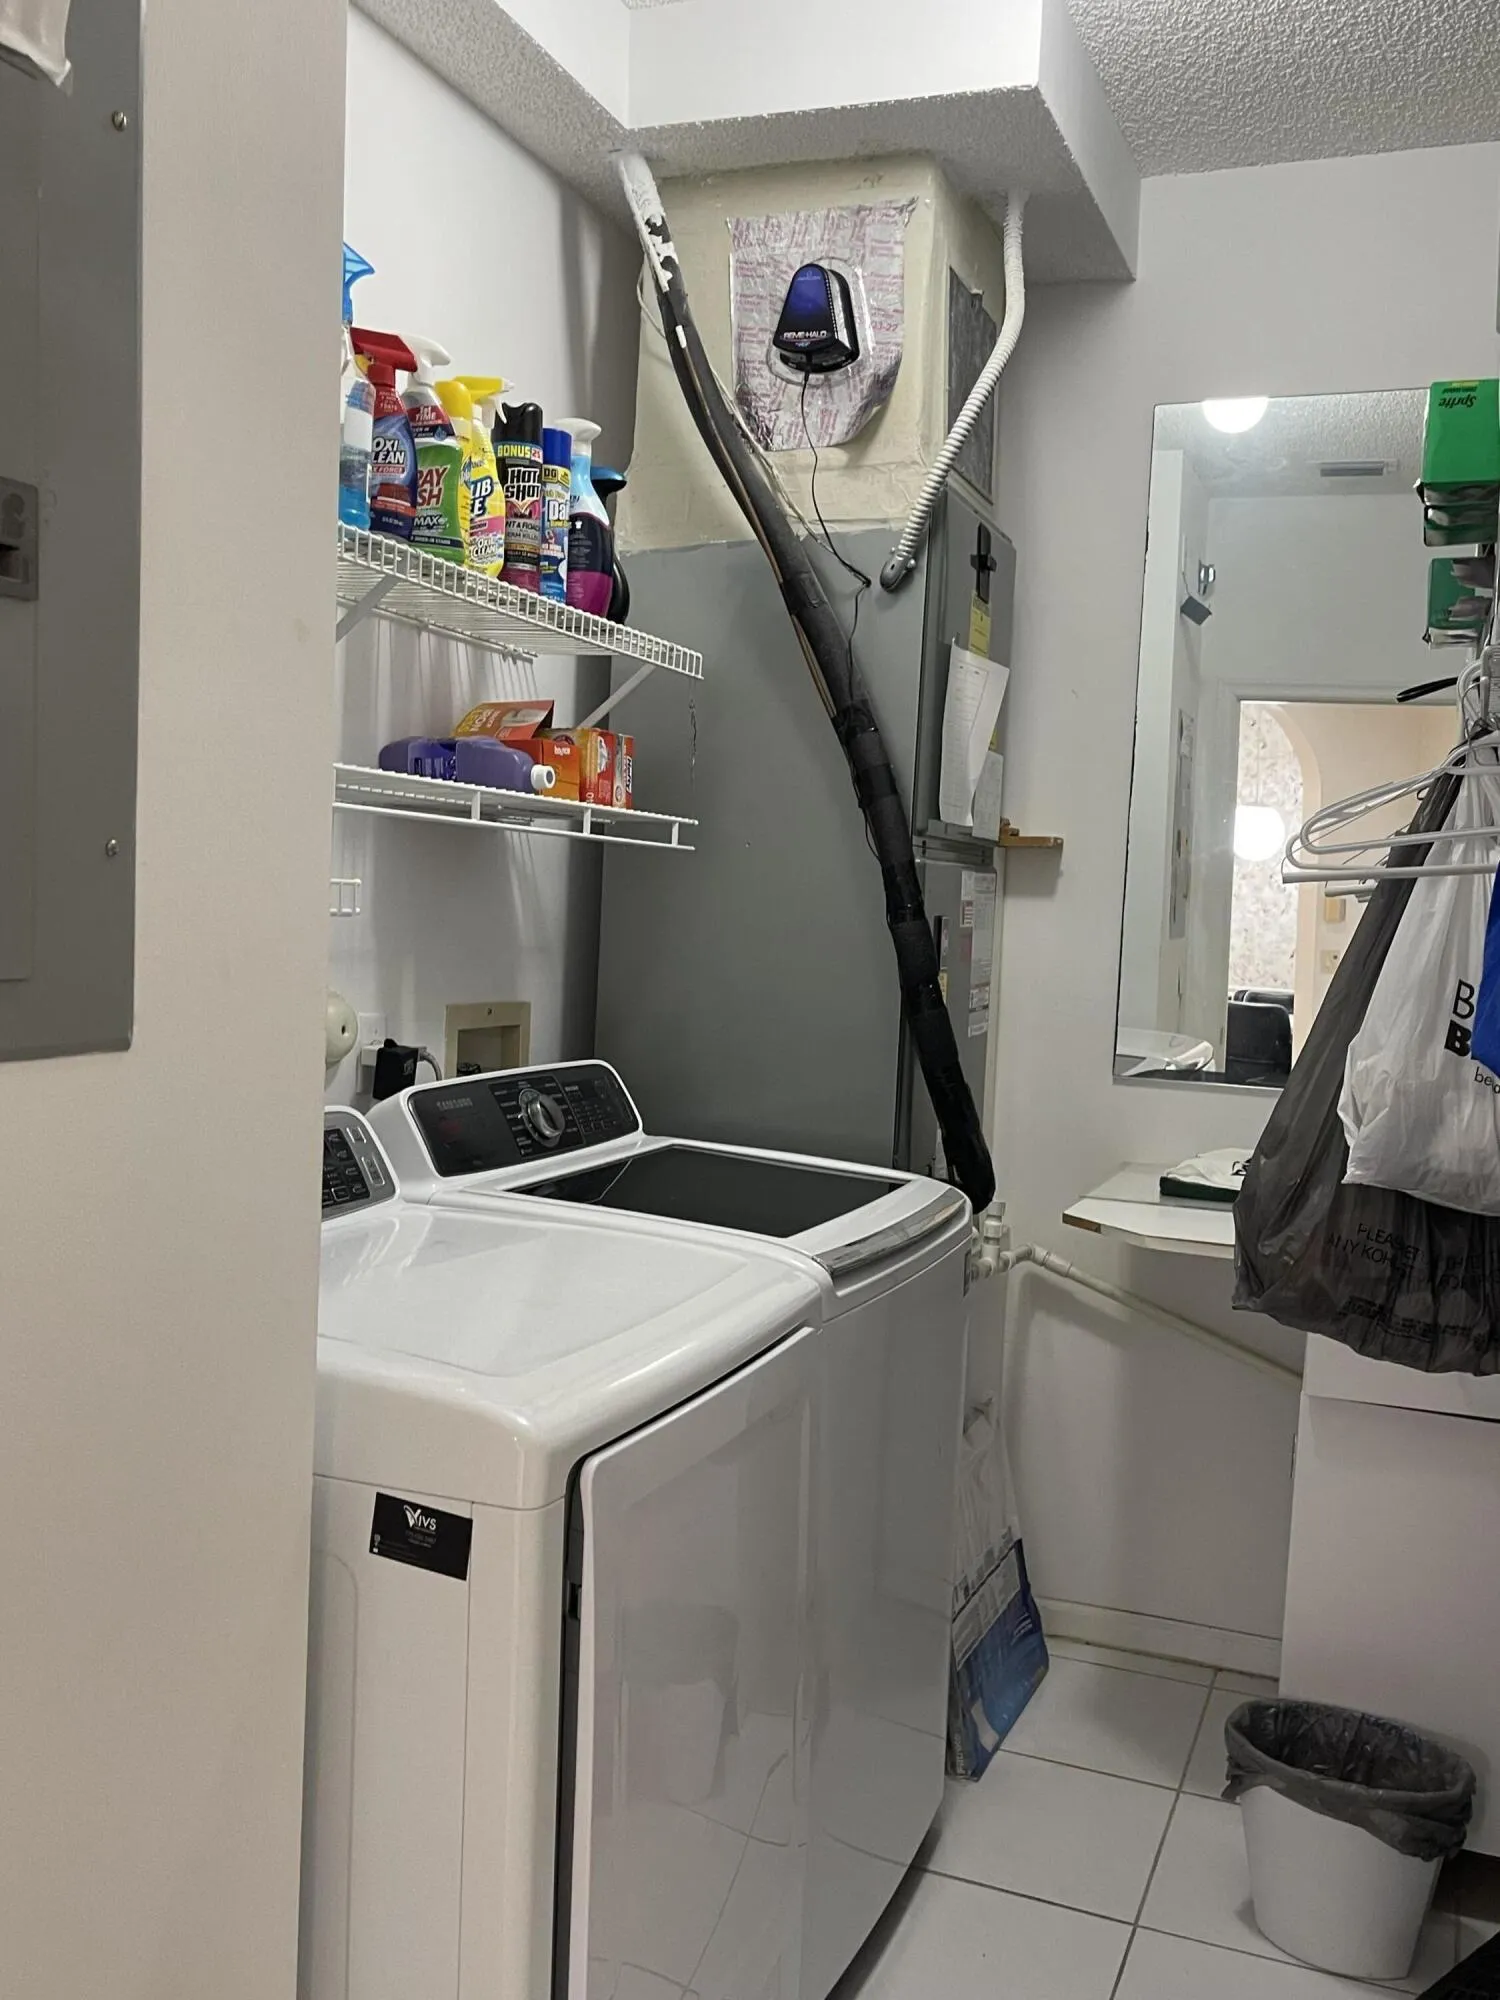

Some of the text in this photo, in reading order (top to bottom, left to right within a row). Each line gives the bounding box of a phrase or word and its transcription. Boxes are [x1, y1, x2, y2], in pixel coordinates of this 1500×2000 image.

[1438, 394, 1477, 408] Sprite
[373, 436, 398, 452] OXI
[497, 444, 531, 459] BONUS
[372, 451, 405, 464] LEAN
[507, 467, 539, 485] HOT
[503, 483, 541, 502] SHOT
[413, 514, 440, 527] MAX
[470, 545, 497, 560] CLEAN
